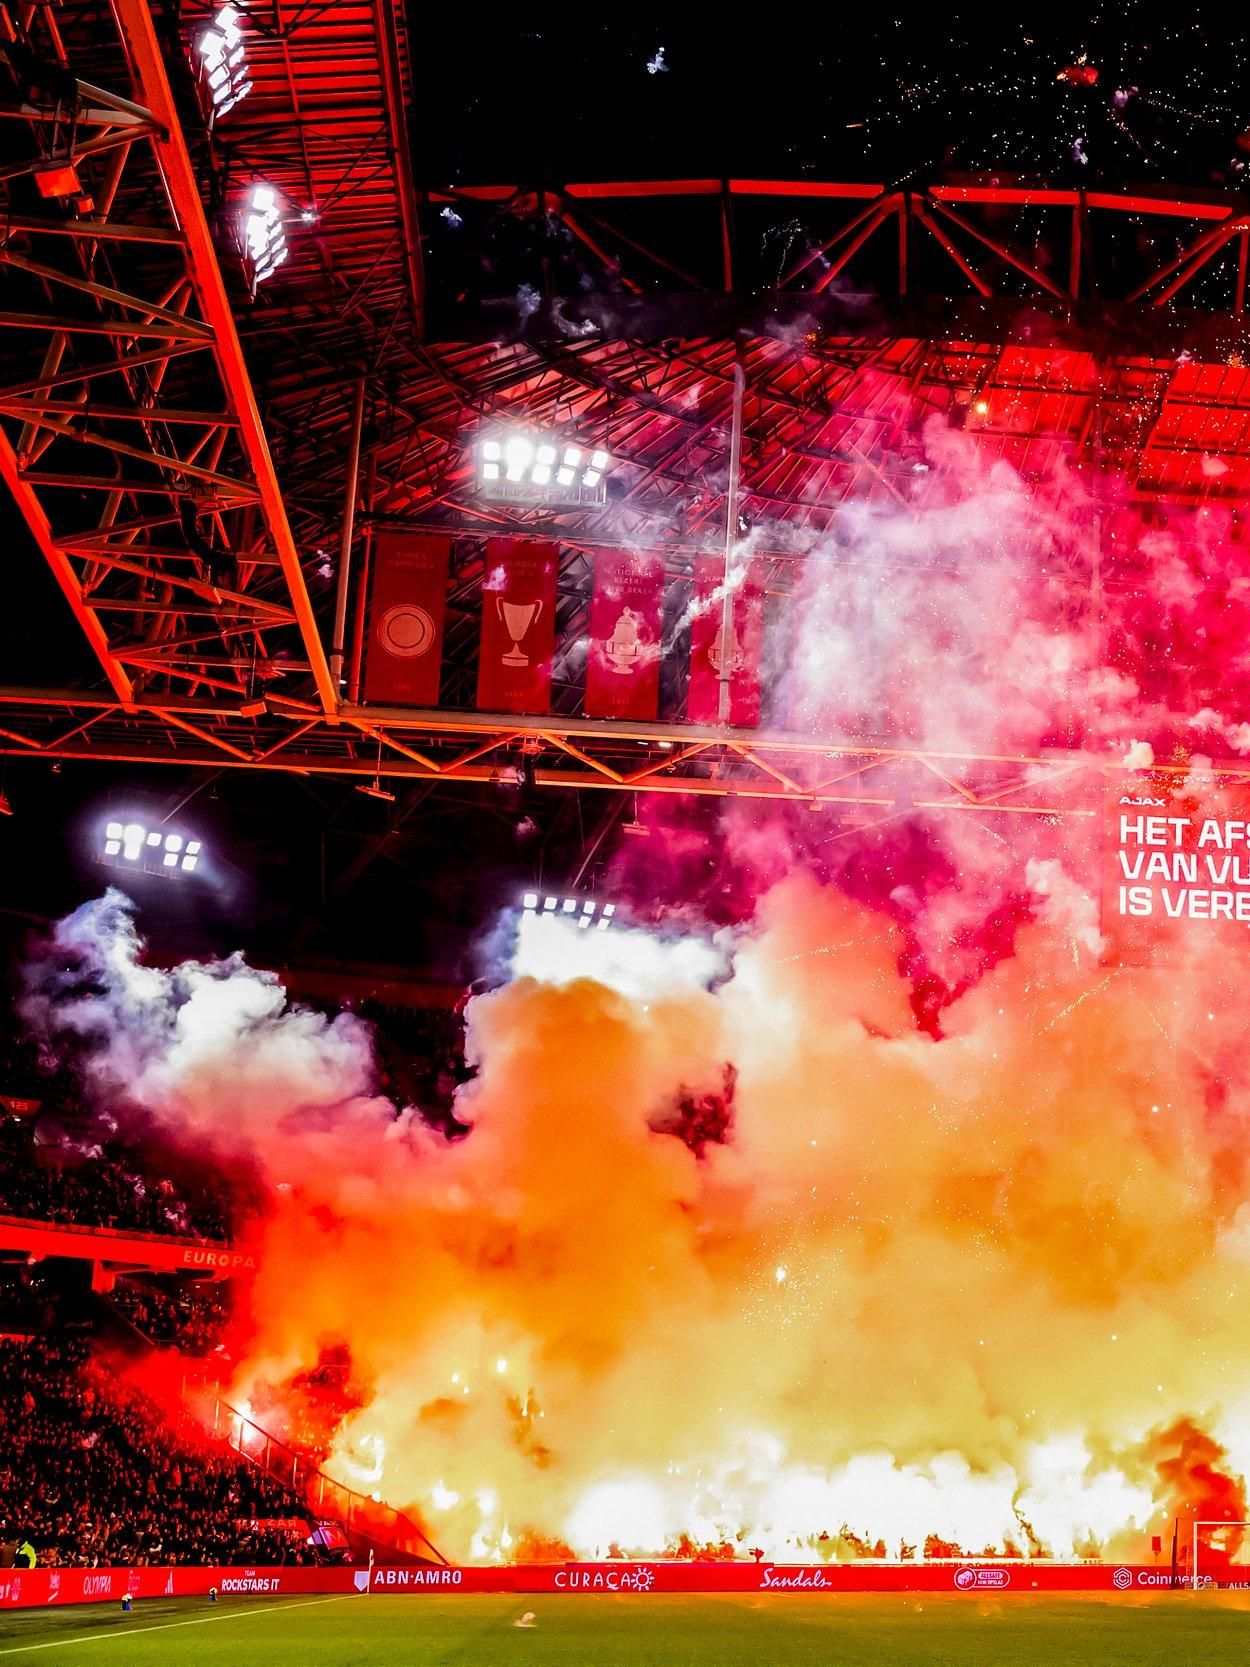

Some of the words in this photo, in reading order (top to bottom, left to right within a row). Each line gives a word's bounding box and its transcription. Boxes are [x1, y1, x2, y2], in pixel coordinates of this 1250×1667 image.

[1118, 796, 1166, 807] AJAX
[1119, 815, 1191, 846] HET
[1118, 850, 1197, 883] VAN
[1119, 886, 1152, 916] IS
[183, 1250, 256, 1268] EUROPA
[83, 1576, 111, 1594] OLYMPIA
[222, 1579, 269, 1591] ROCKSTARS
[270, 1578, 280, 1590] IT
